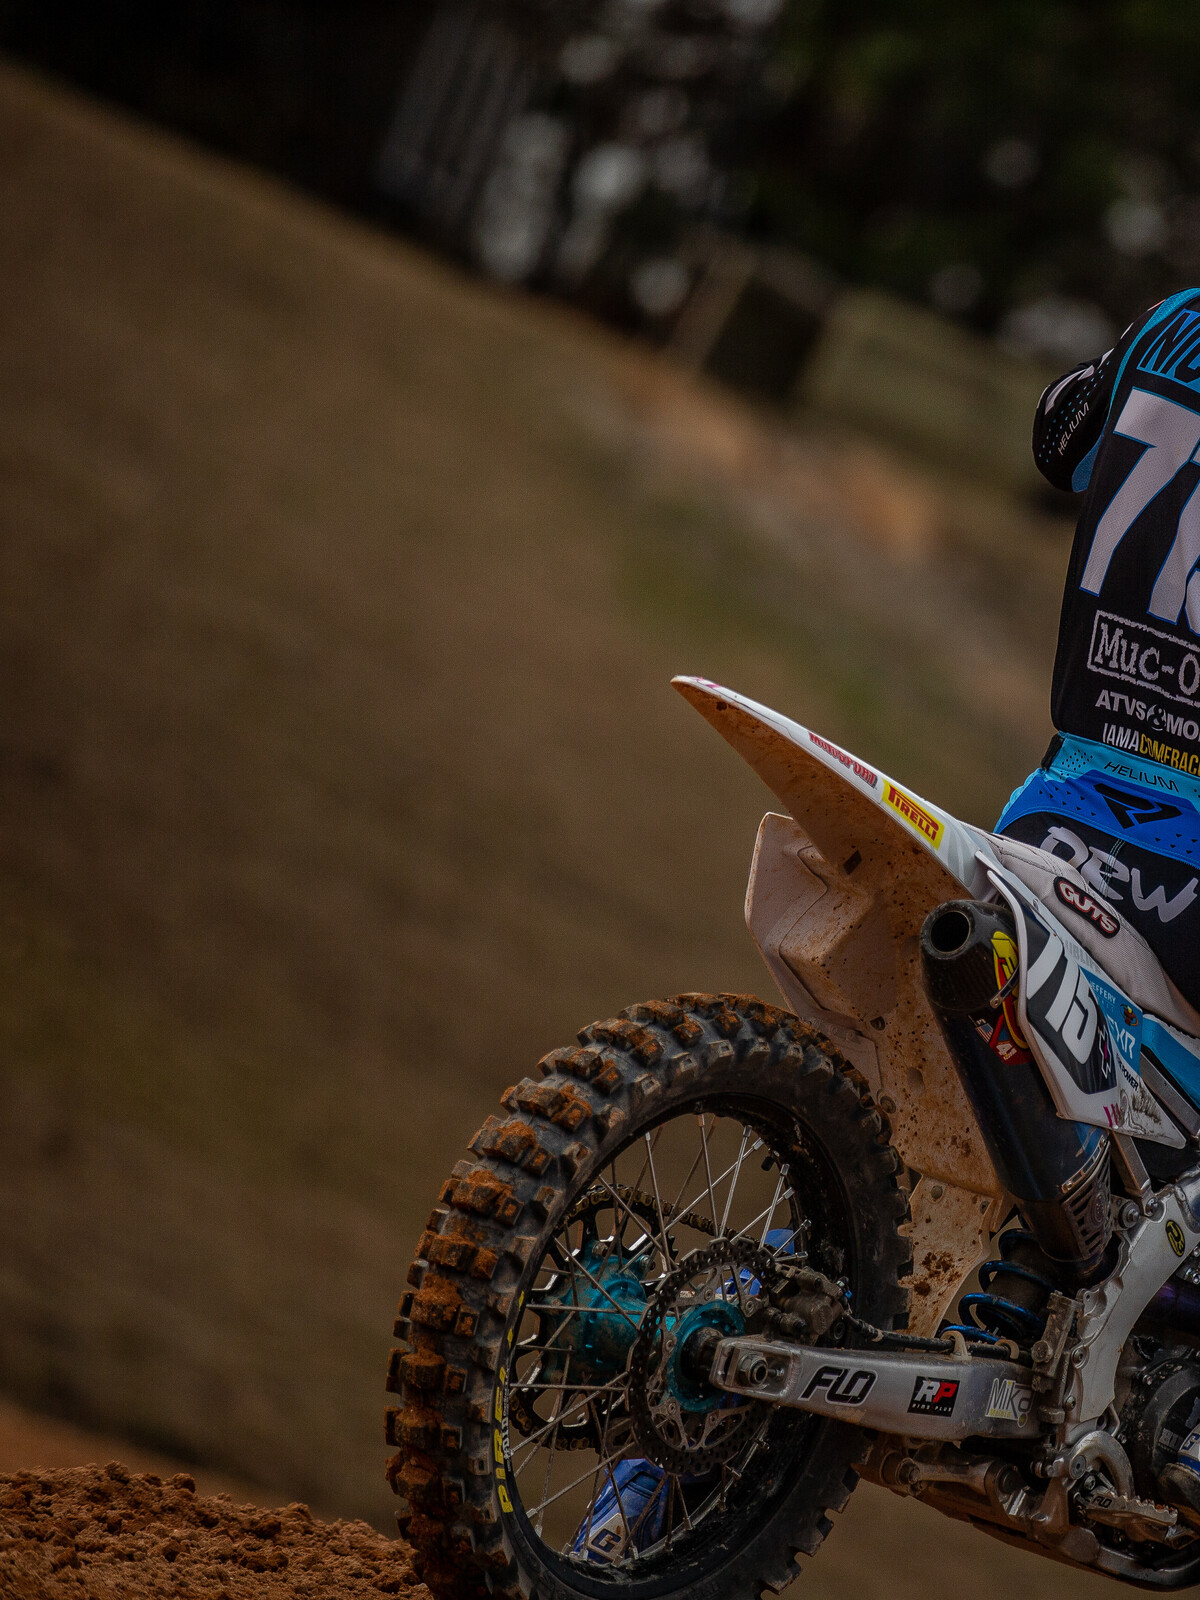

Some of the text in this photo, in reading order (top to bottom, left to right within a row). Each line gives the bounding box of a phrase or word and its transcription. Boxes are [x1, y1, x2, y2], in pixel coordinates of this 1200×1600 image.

[1058, 402, 1090, 456] HELIUM
[1104, 761, 1180, 793] HELIUM
[888, 784, 940, 841] PIRELLI
[1059, 880, 1119, 935] GUTS
[802, 1367, 875, 1404] FLO
[914, 1380, 958, 1404] RP
